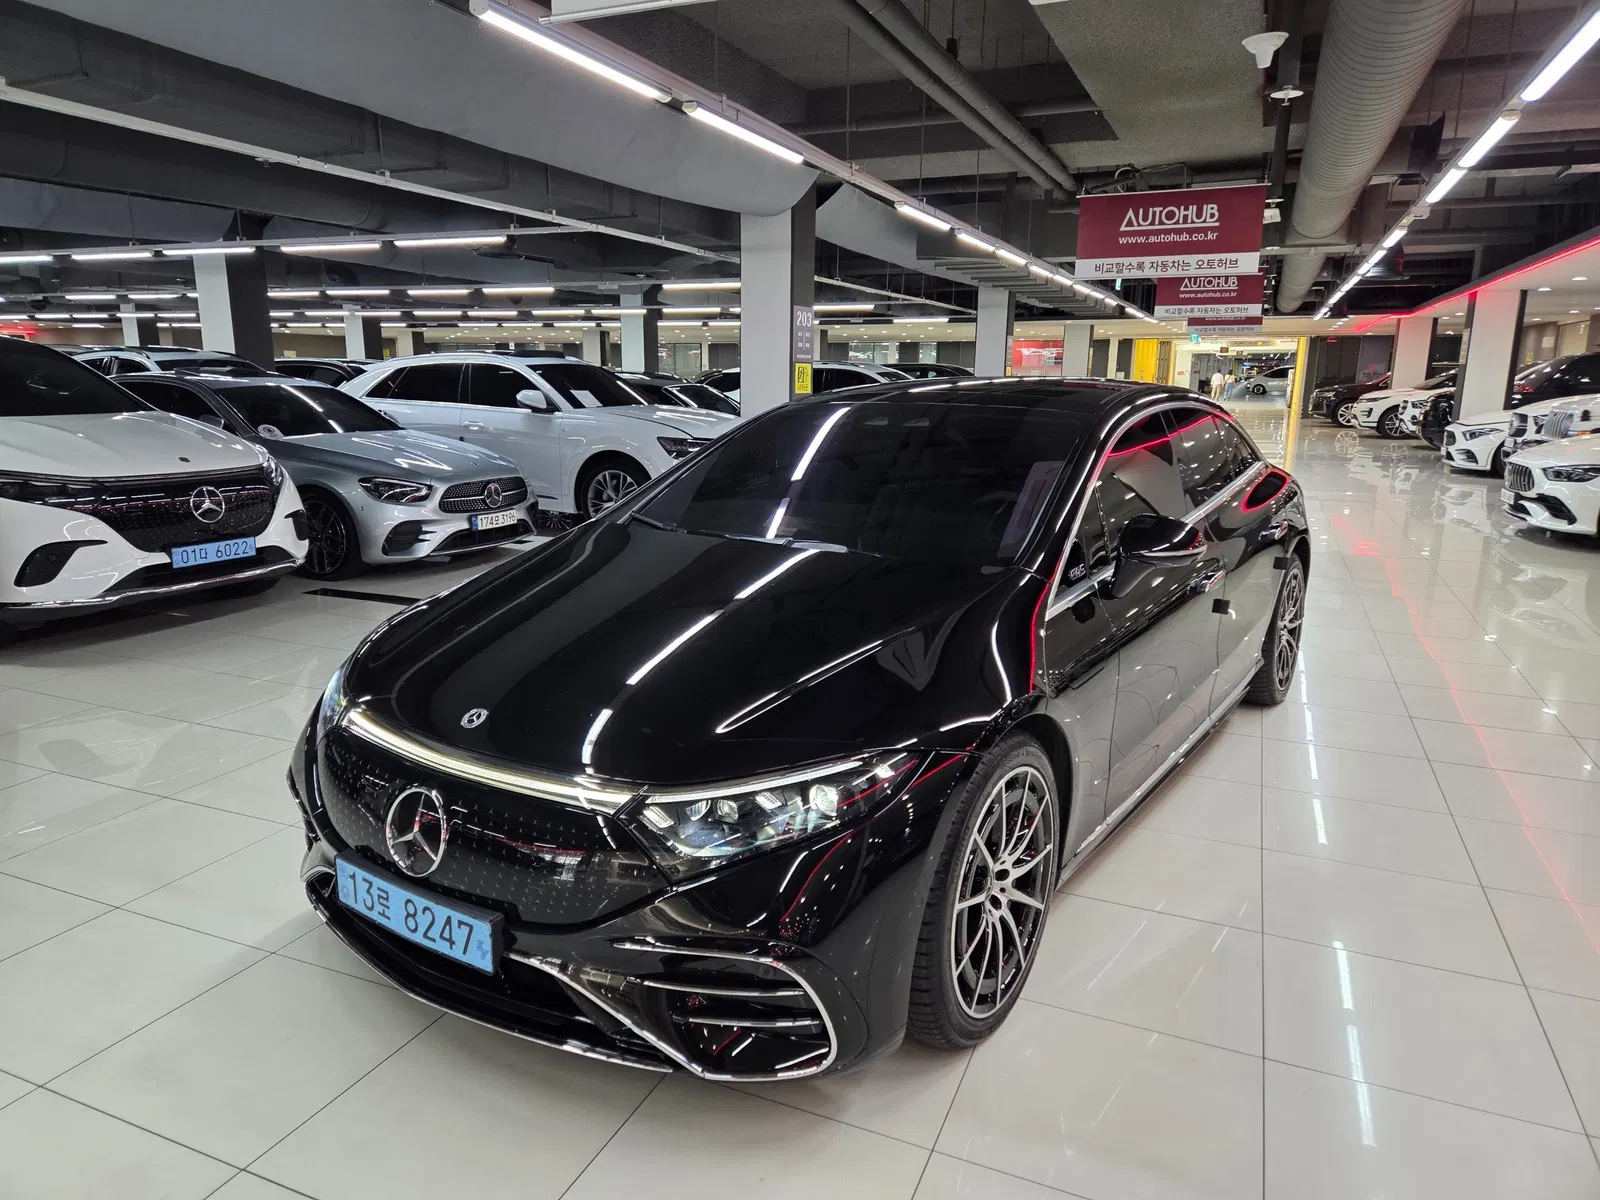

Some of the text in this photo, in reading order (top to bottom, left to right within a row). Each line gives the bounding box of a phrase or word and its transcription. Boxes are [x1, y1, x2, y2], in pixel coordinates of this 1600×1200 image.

[1119, 203, 1220, 231] AUTOHUB
[1118, 230, 1219, 244] www.autohub.co.kr
[1094, 257, 1239, 275] 비교할수록 자동차는 오토허브
[1180, 276, 1238, 290] AUTOHUB
[796, 310, 812, 327] 203
[1164, 307, 1195, 315] 비교할수록
[1197, 306, 1222, 314] 자동차는
[180, 548, 208, 564] 01다
[215, 540, 249, 559] 6022
[348, 871, 474, 955] 13로 8247
